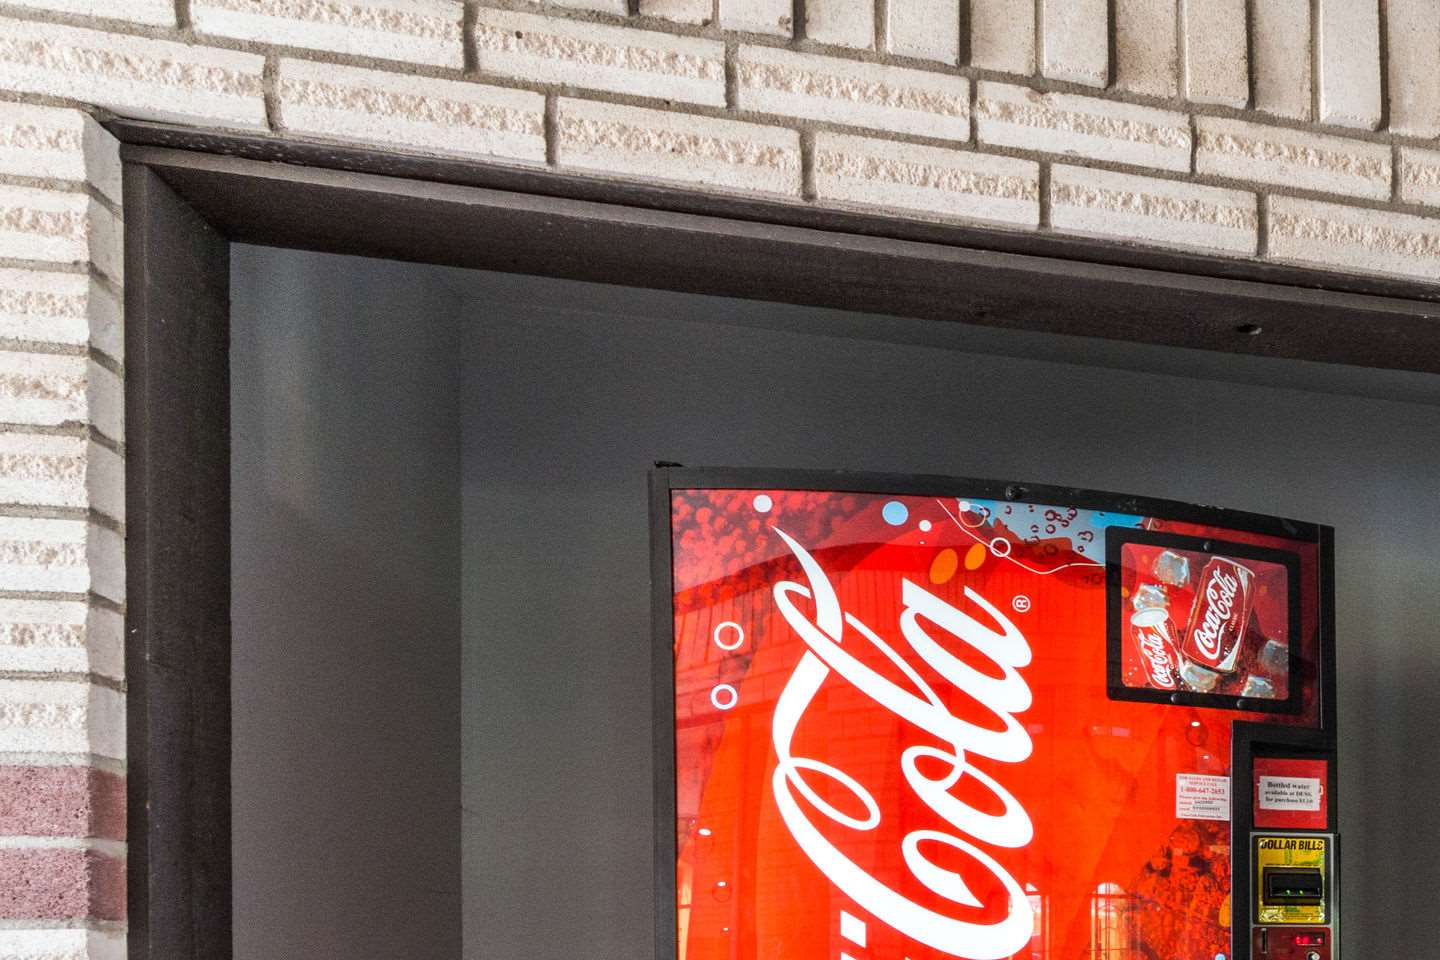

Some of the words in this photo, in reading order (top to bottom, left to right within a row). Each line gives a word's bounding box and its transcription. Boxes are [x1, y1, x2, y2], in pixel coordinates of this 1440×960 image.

[1194, 565, 1238, 660] Coca-Cola
[1261, 839, 1298, 850] DOLLAR
[1298, 840, 1323, 851] BILLS
